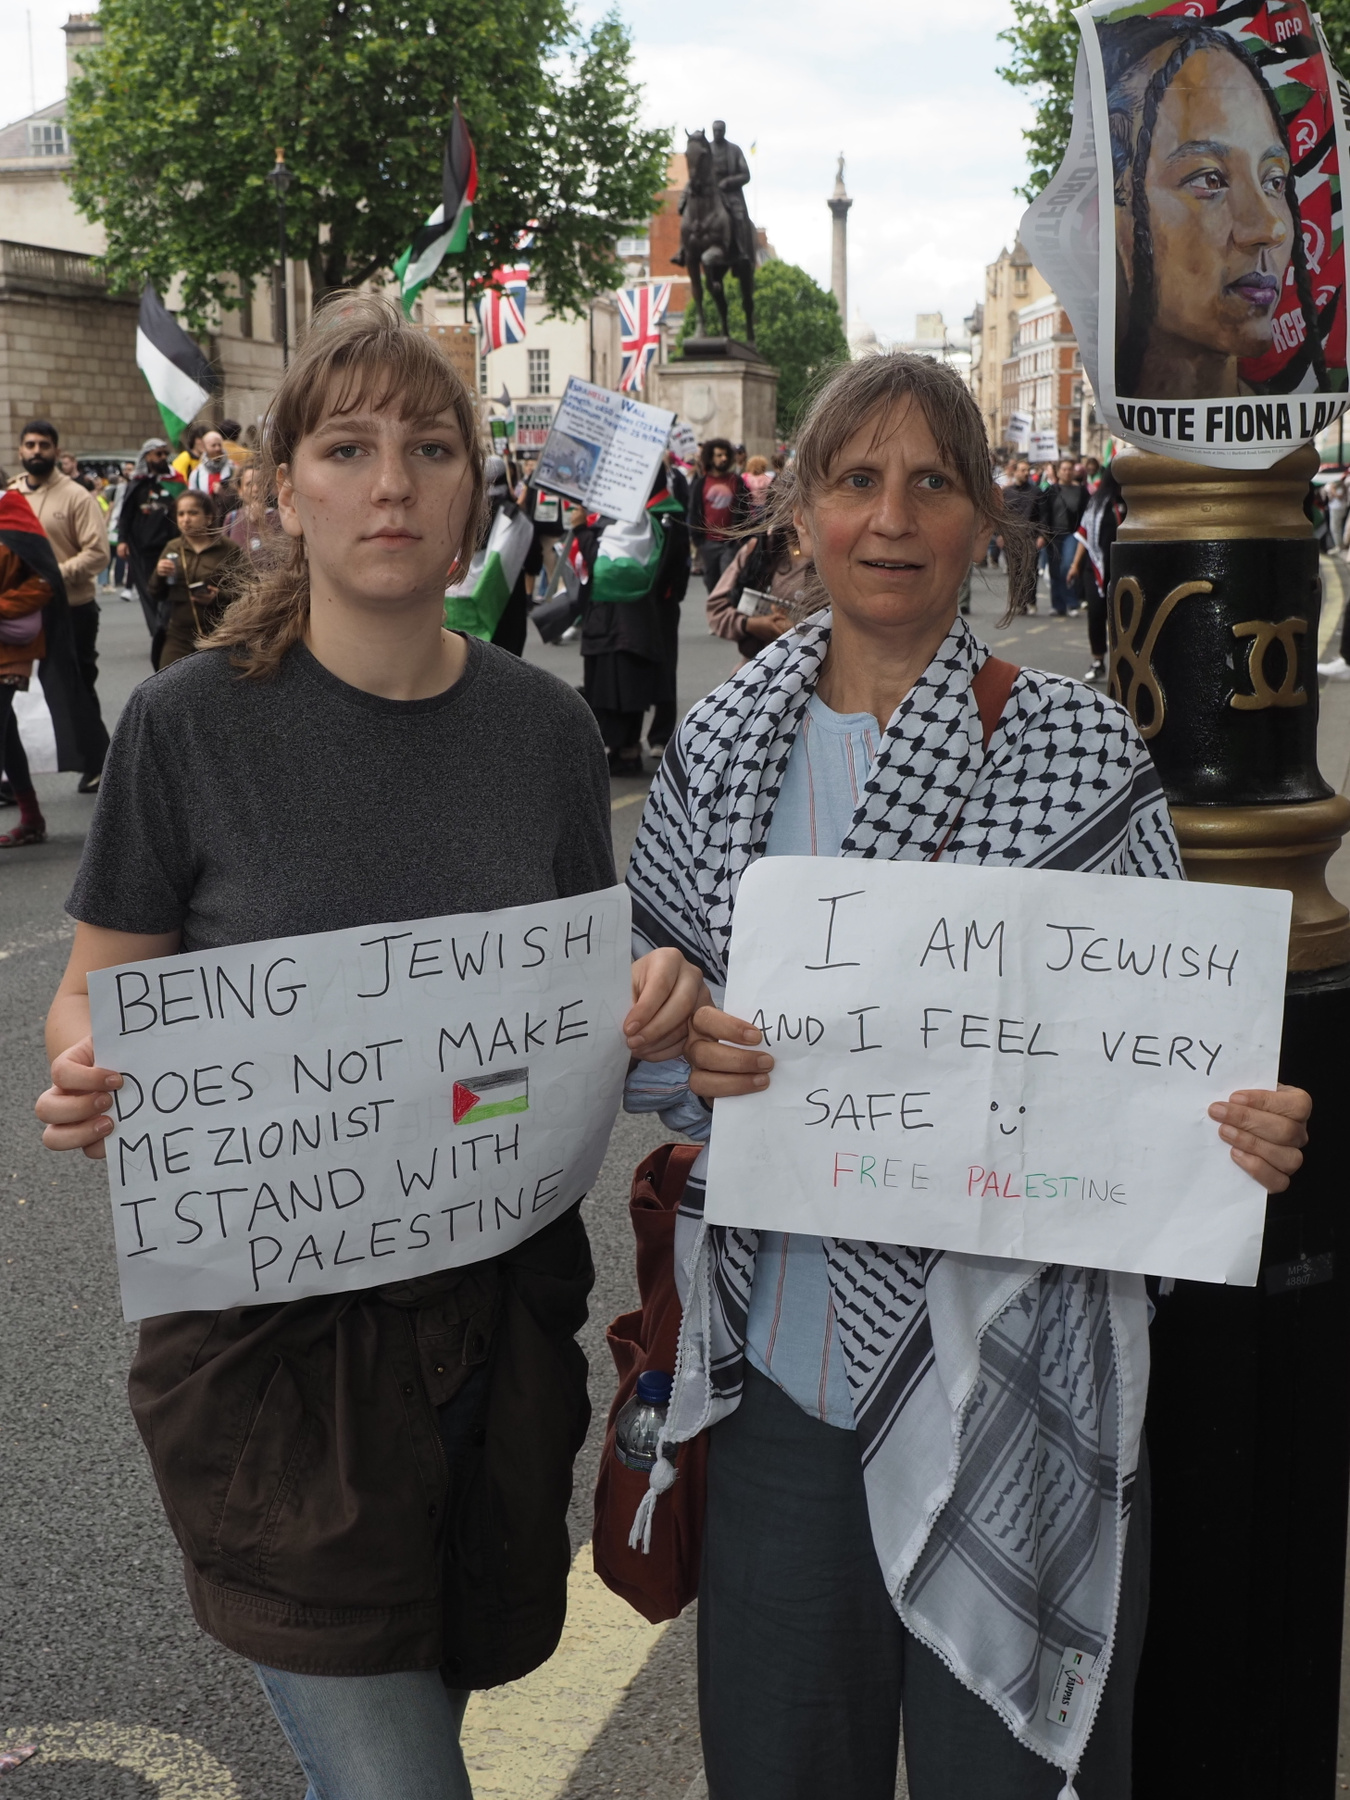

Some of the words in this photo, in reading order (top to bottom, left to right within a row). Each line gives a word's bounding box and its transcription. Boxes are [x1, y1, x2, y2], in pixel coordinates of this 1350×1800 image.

[1271, 308, 1306, 353] RCP
[1116, 403, 1195, 442] VOTE
[1206, 403, 1292, 443] FIONA
[805, 890, 866, 970] I
[920, 917, 1004, 977] AM
[1046, 923, 1239, 986] JEWISH
[116, 957, 306, 1035] BEING
[358, 916, 592, 998] JEWISH
[115, 1061, 254, 1121] DOES
[294, 1040, 402, 1097] NOT
[439, 1000, 588, 1072] MAKE
[752, 1009, 825, 1047] AND
[848, 1006, 882, 1053] I
[921, 1008, 1058, 1057] FEEL
[1101, 1030, 1223, 1076] VERY
[804, 1089, 934, 1131] SAFE
[398, 1124, 520, 1197] WITH
[833, 1152, 929, 1190] FREE
[967, 1165, 1127, 1206] PALESTINE
[249, 1169, 564, 1292] PALESTINE
